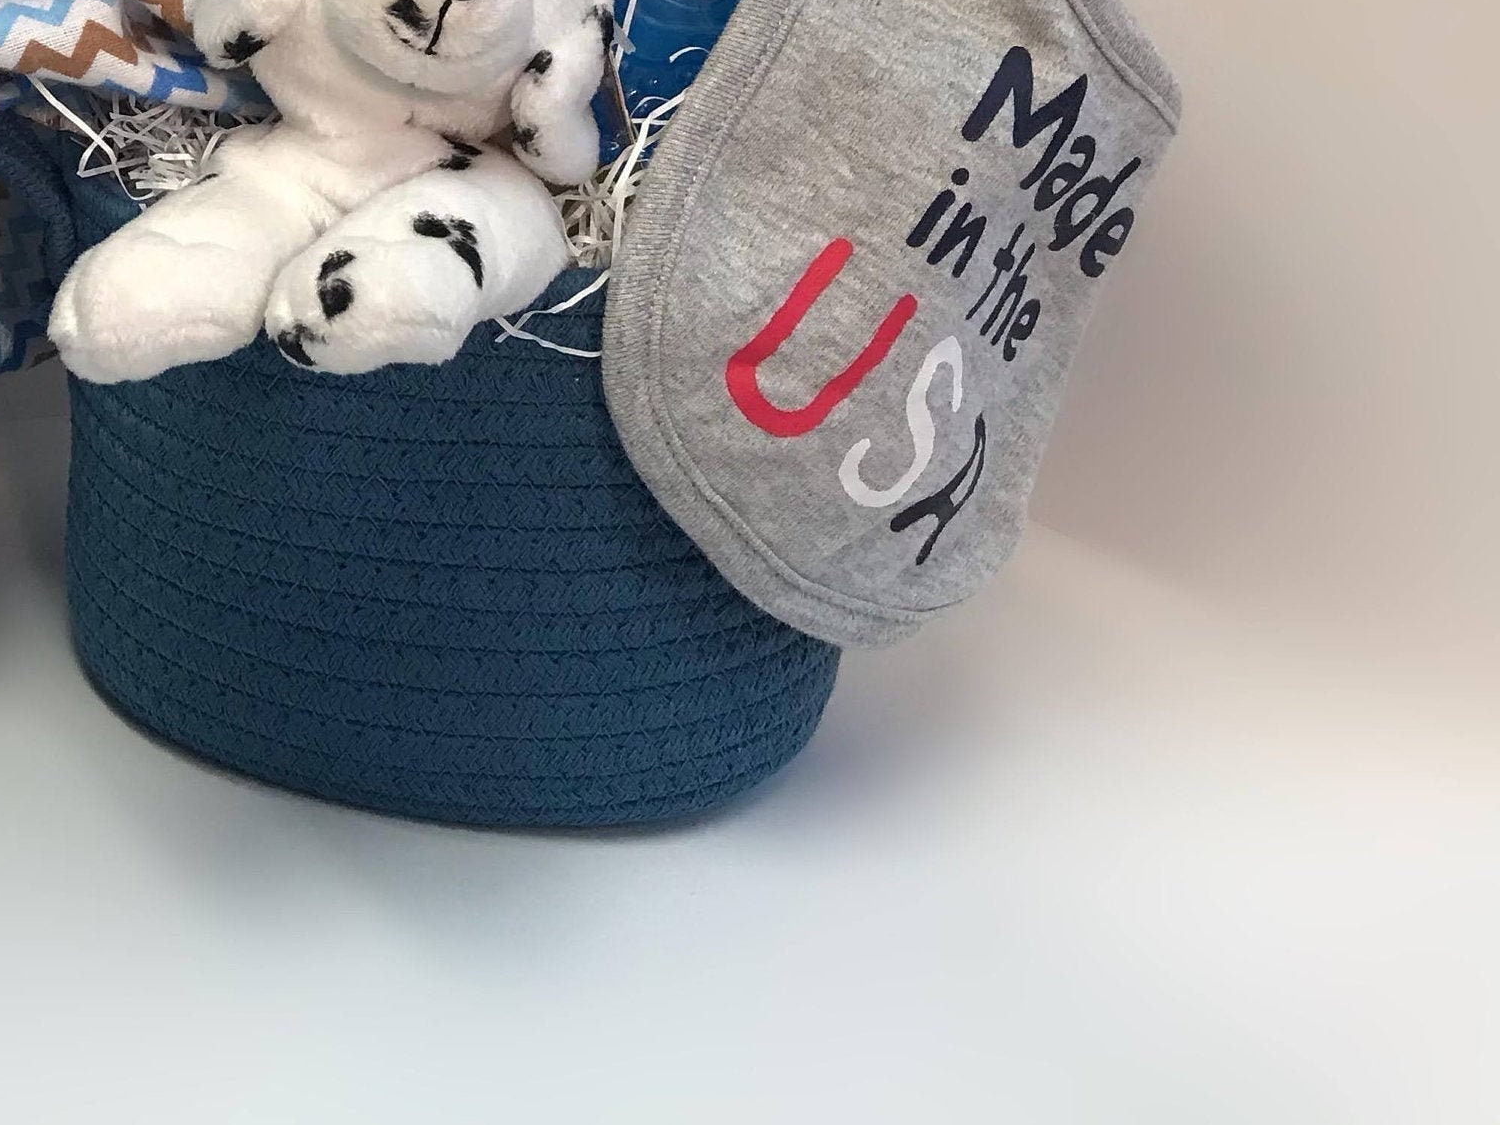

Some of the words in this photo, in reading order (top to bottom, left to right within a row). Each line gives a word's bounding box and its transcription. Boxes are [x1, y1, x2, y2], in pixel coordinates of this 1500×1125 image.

[905, 168, 987, 278] in
[965, 223, 1041, 362] the
[961, 46, 1142, 278] Made
